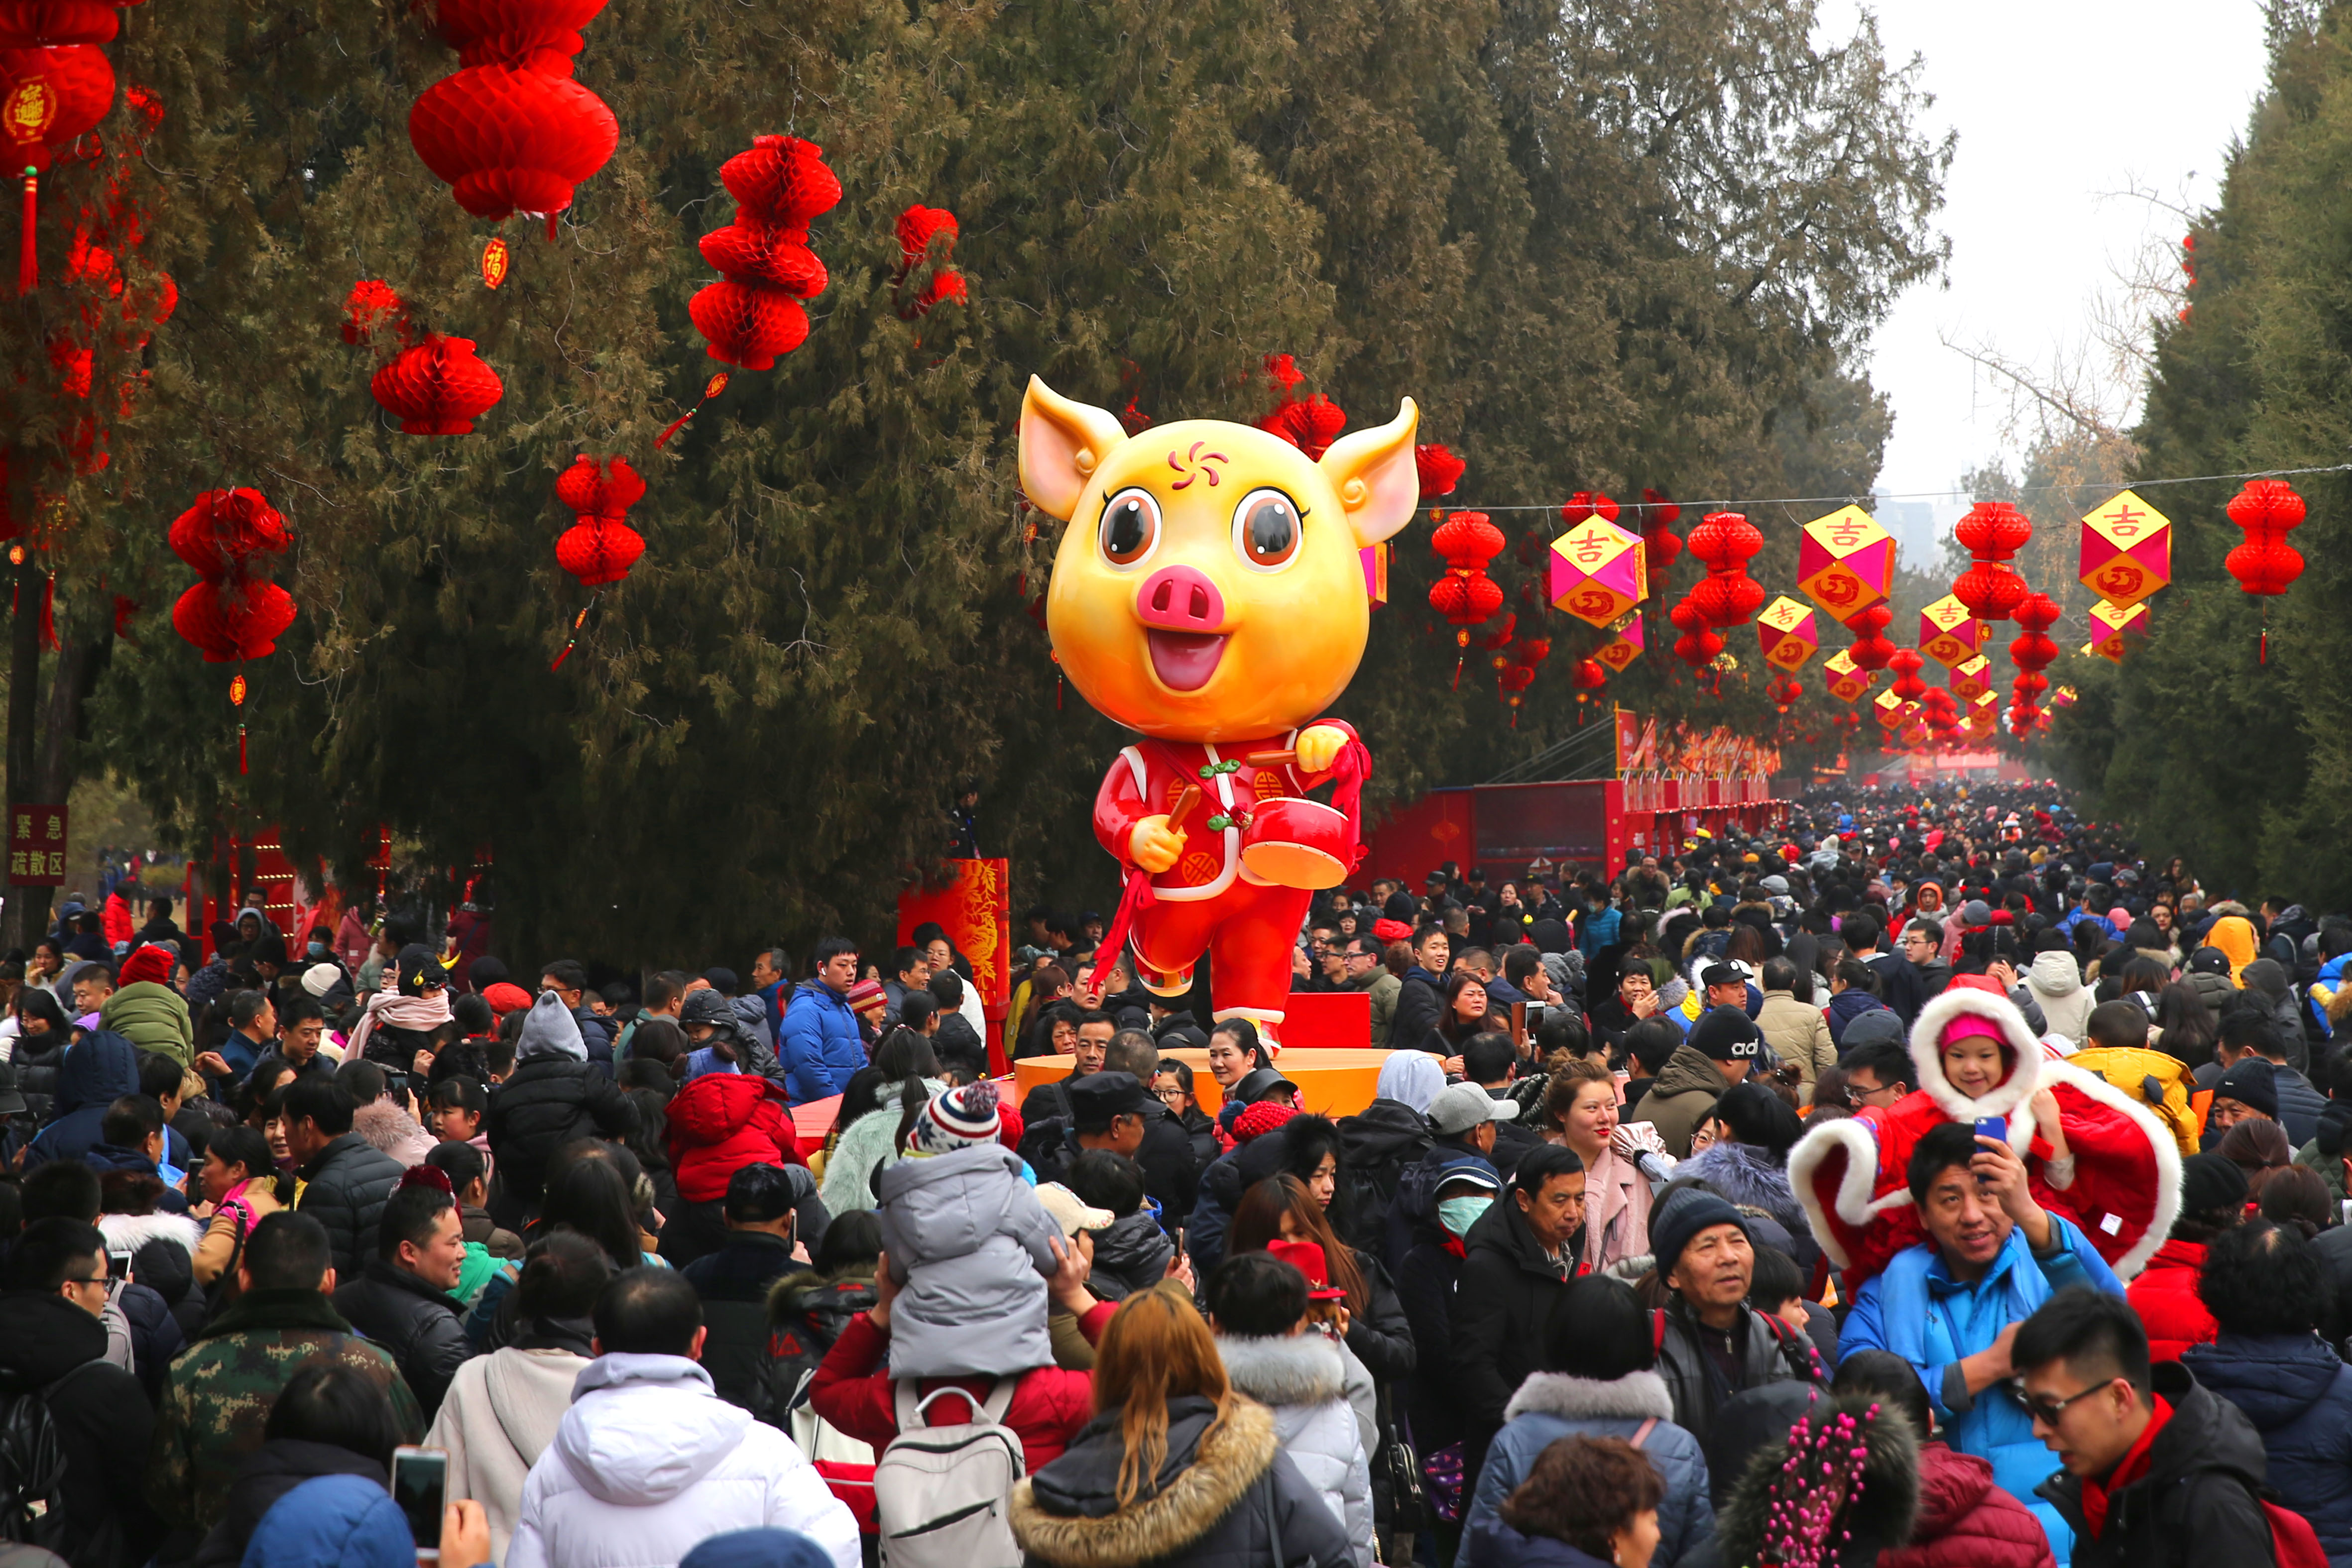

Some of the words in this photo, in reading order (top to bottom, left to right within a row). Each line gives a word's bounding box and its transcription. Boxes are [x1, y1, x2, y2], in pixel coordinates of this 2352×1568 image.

[1826, 517, 1868, 546] 吉
[2104, 504, 2146, 536] 吉
[1570, 529, 1610, 562] 吉
[1770, 604, 1796, 625] 吉
[1935, 602, 1962, 623] 吉
[16, 814, 62, 840] 紧急
[11, 850, 63, 876] 疏散区
